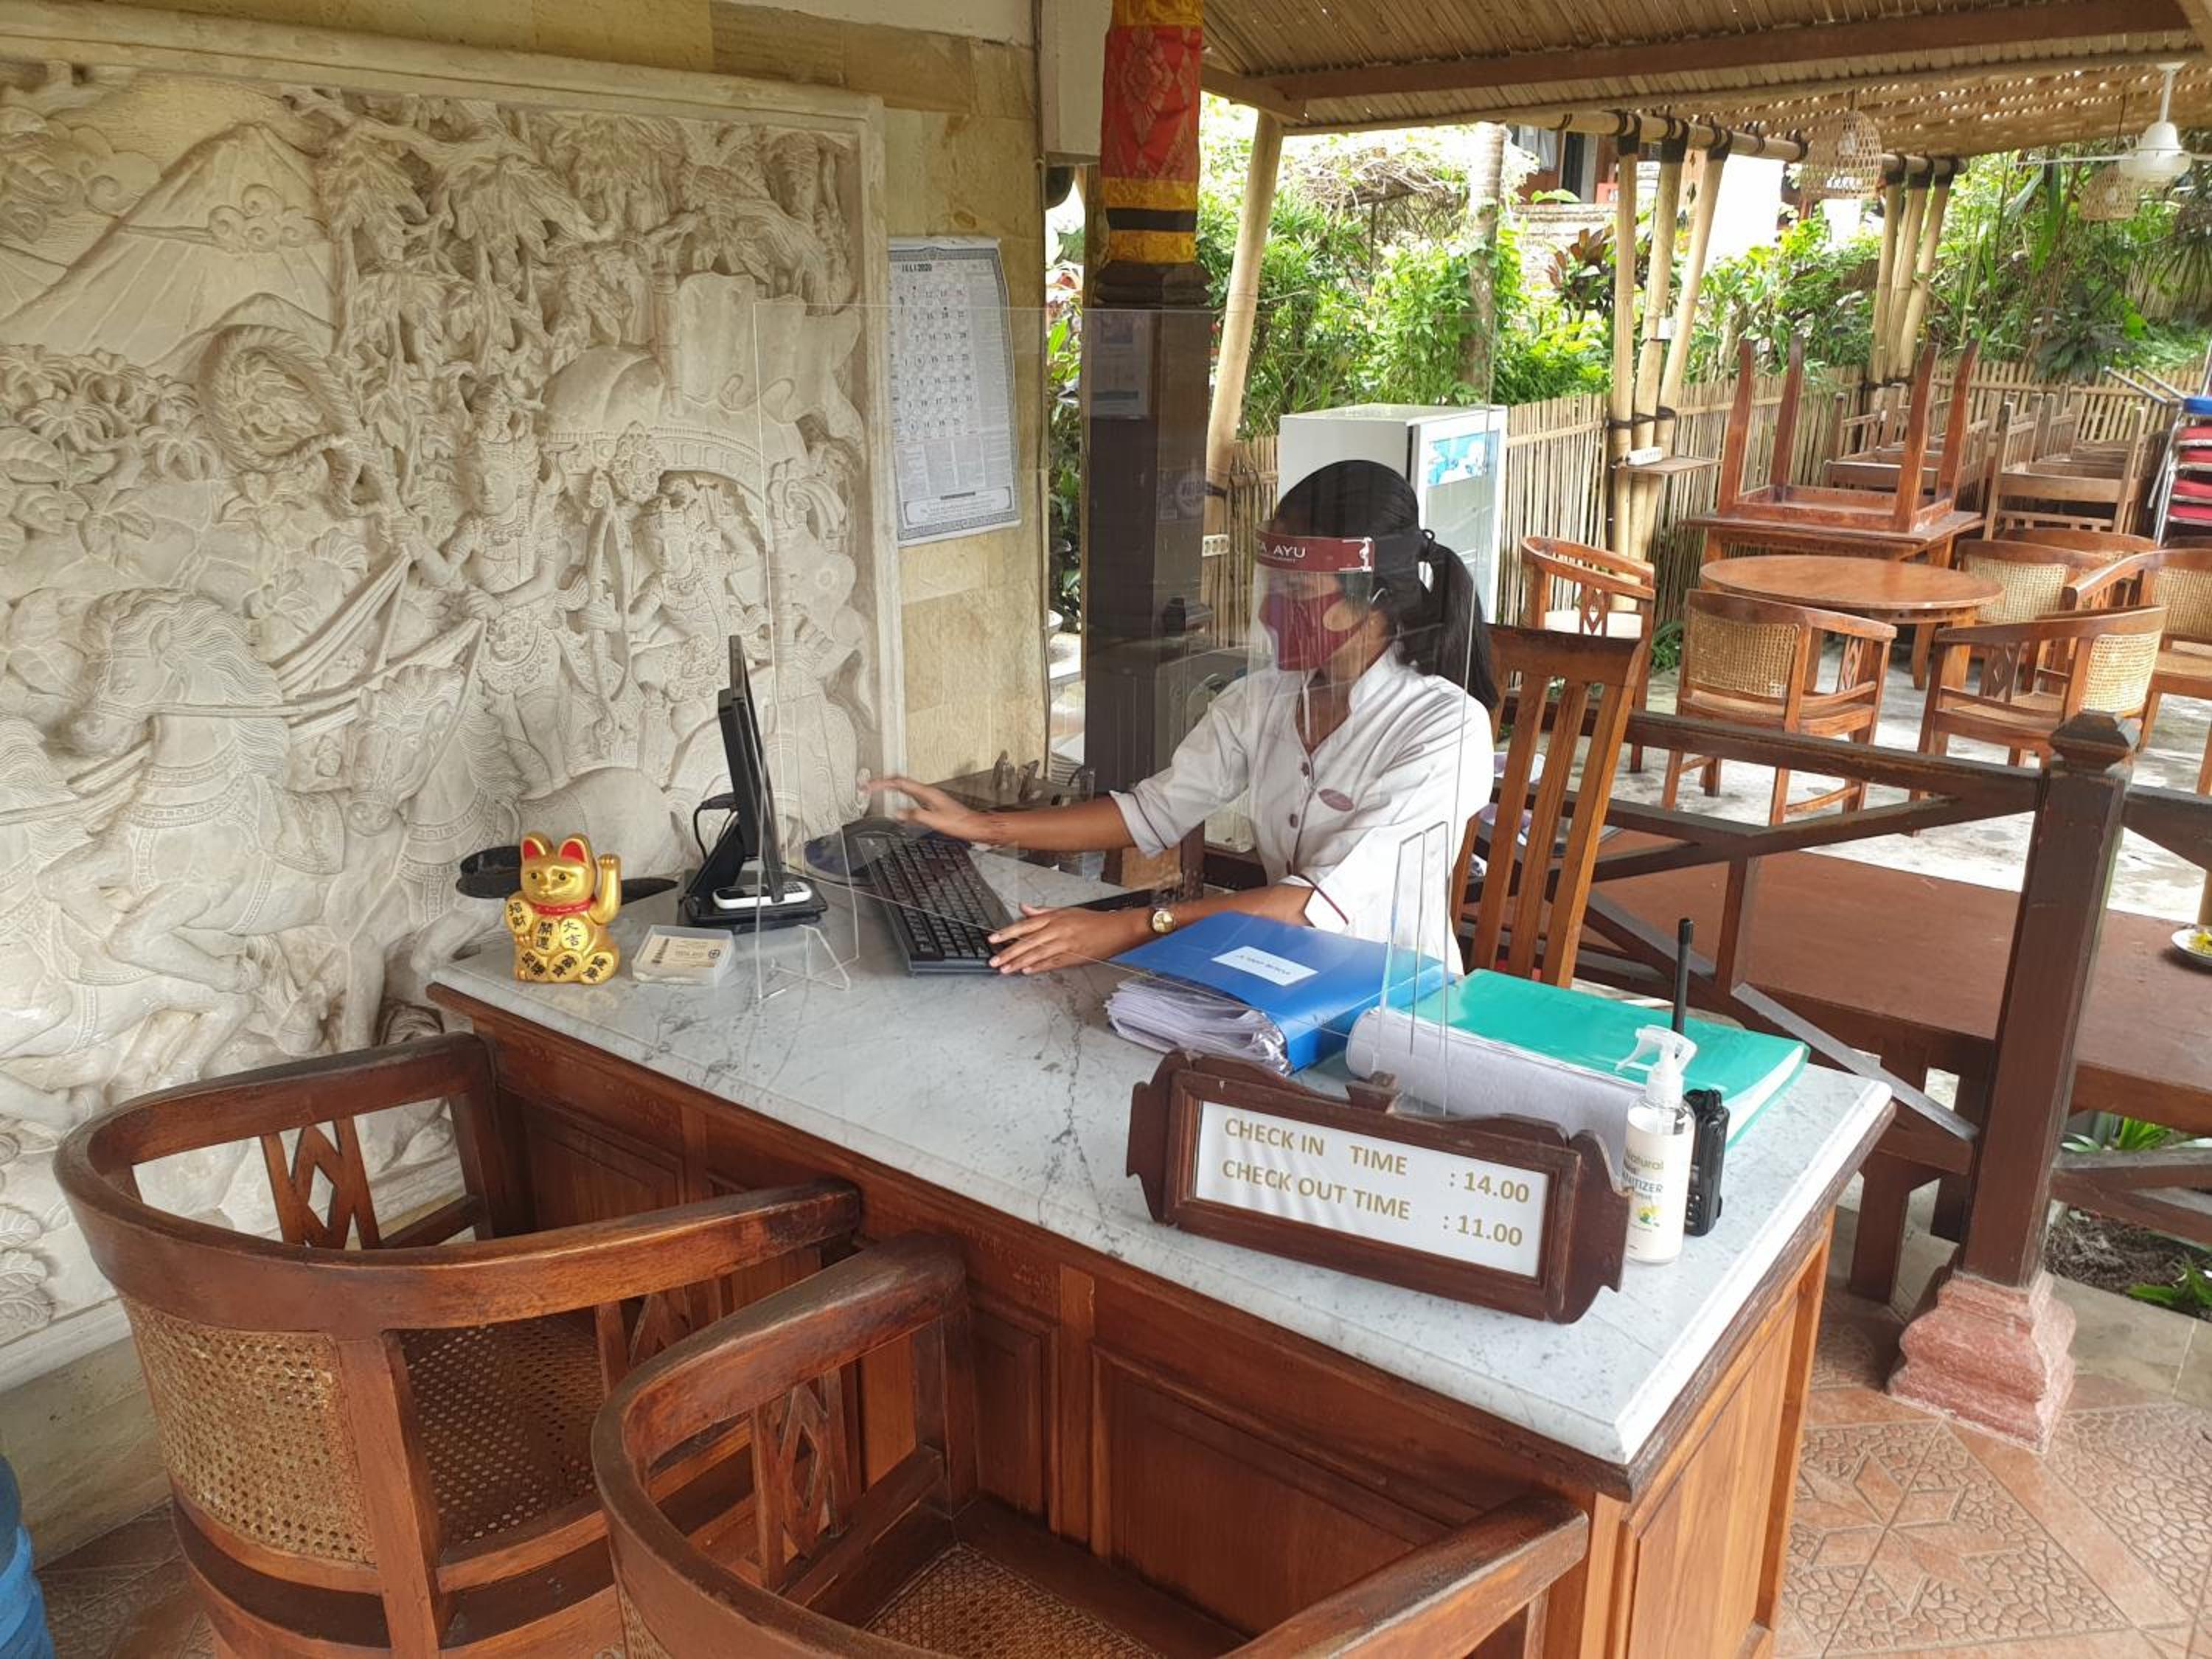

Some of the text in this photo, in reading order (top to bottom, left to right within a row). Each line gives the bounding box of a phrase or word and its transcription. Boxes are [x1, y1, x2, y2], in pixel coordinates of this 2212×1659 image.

[1273, 544, 1306, 559] AYU
[1224, 1117, 1295, 1150] CHECK
[1301, 1134, 1325, 1157] IN
[1350, 1144, 1408, 1176] TIME
[1222, 1159, 1293, 1192] CHECK
[1298, 1177, 1347, 1204] OUT
[1353, 1189, 1411, 1220] TIME
